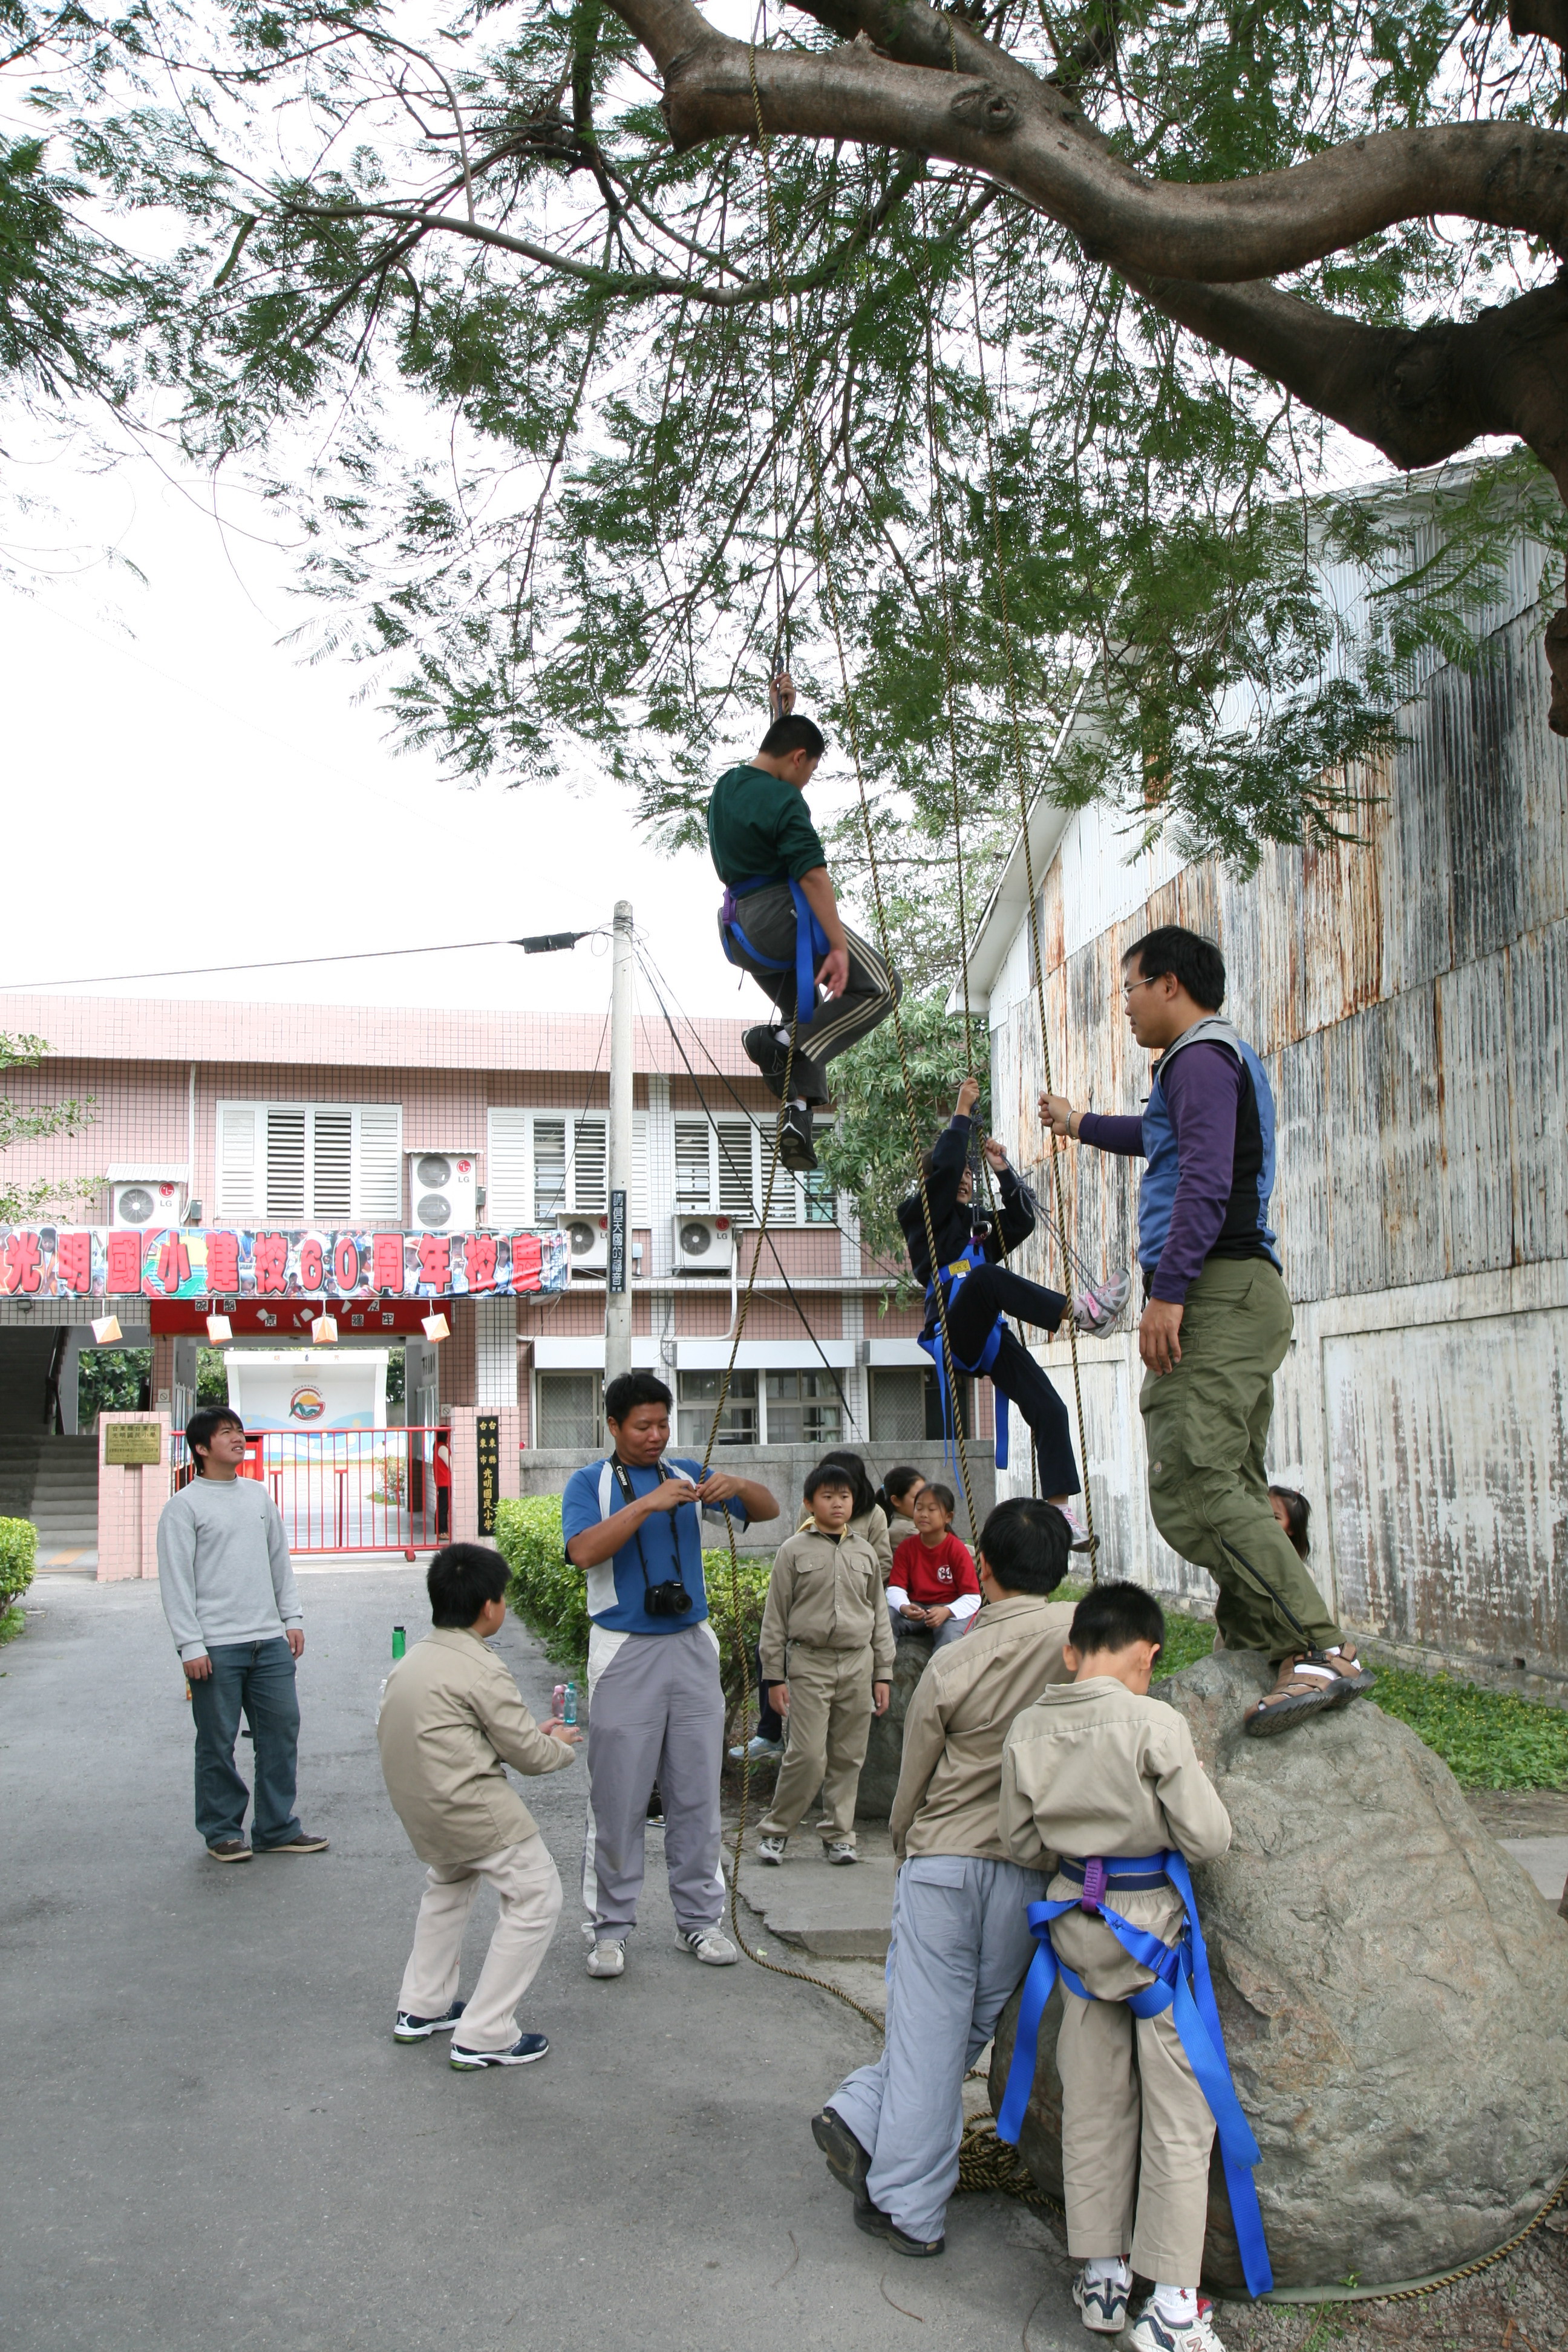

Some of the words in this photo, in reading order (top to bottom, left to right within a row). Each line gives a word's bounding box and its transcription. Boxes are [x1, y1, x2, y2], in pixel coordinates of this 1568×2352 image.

[4, 1230, 543, 1294] 光明國小建校60周年校慶
[612, 1194, 623, 1285] 請信天國的福音
[483, 1468, 493, 1530] 光明國民小學
[616, 1466, 627, 1486] Canon
